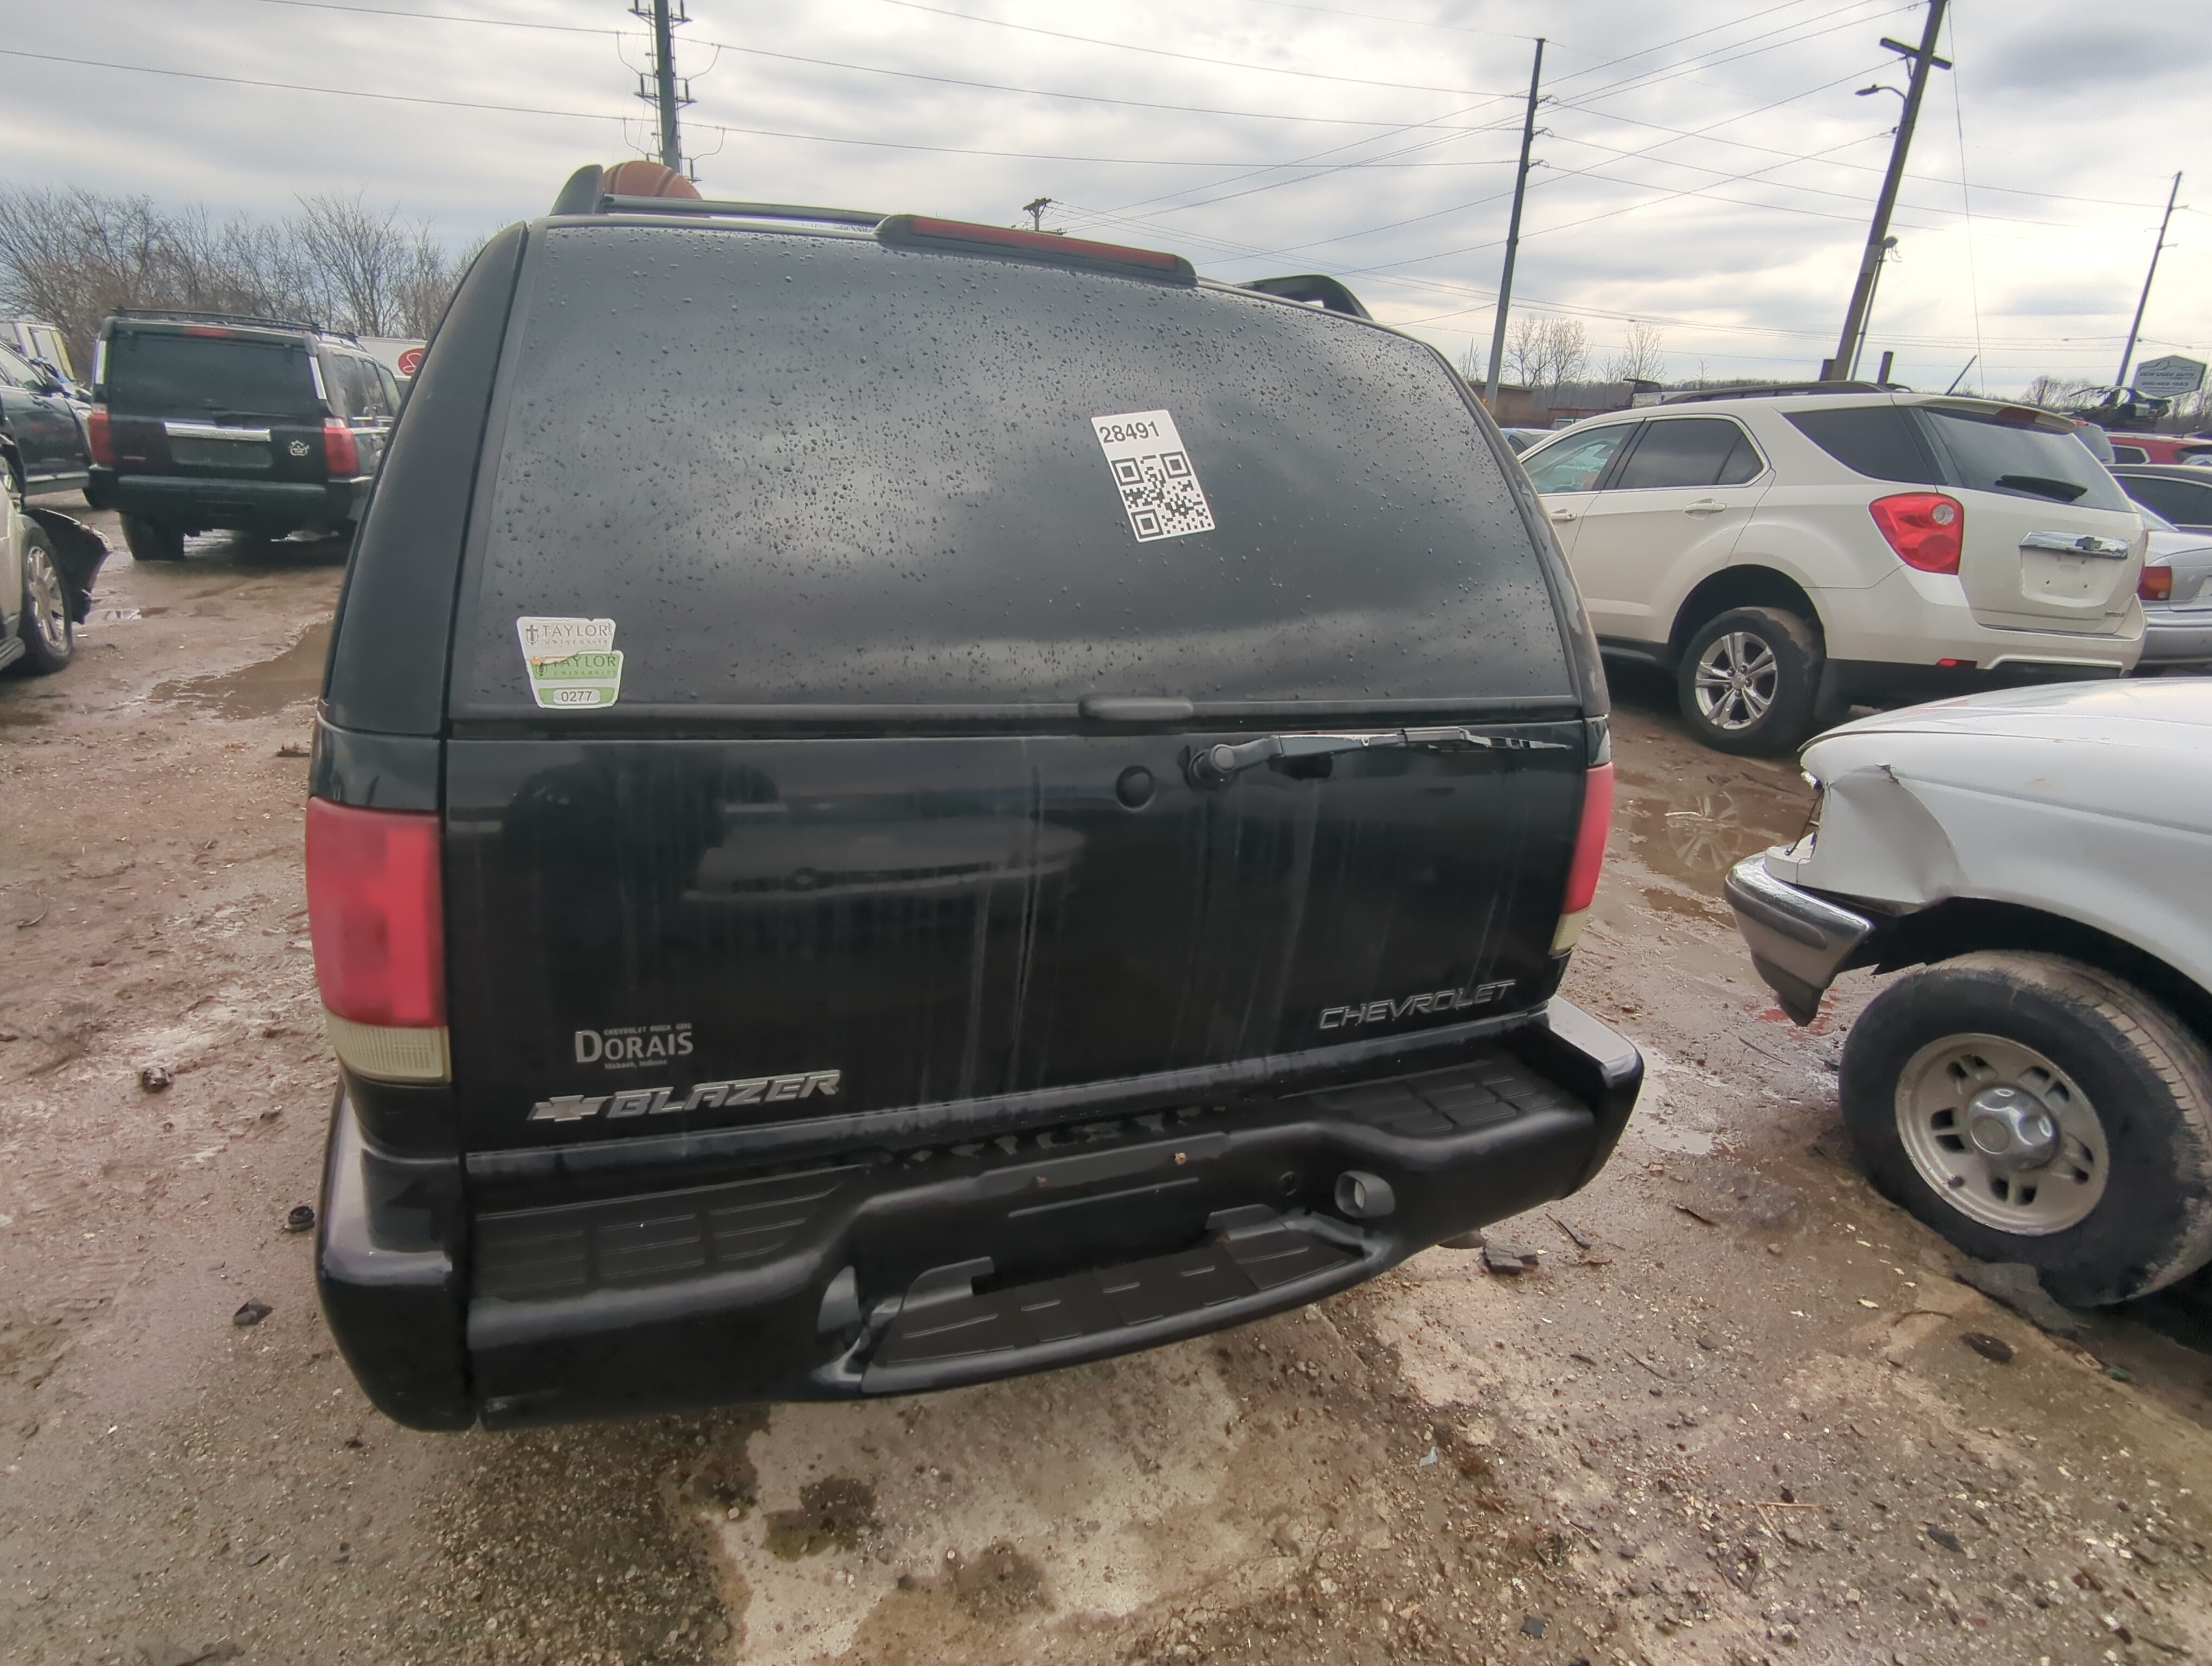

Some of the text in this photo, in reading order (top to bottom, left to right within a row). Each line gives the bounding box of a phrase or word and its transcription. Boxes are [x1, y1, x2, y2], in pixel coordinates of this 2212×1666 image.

[1099, 421, 1160, 444] 28491
[542, 625, 608, 637] TAYLOR
[561, 691, 593, 702] 0277
[1320, 979, 1516, 1029] CHEVROLET
[604, 1026, 647, 1036] CHEVROLET
[575, 1029, 693, 1063] DORAIS
[606, 1069, 840, 1118] BLAZER
